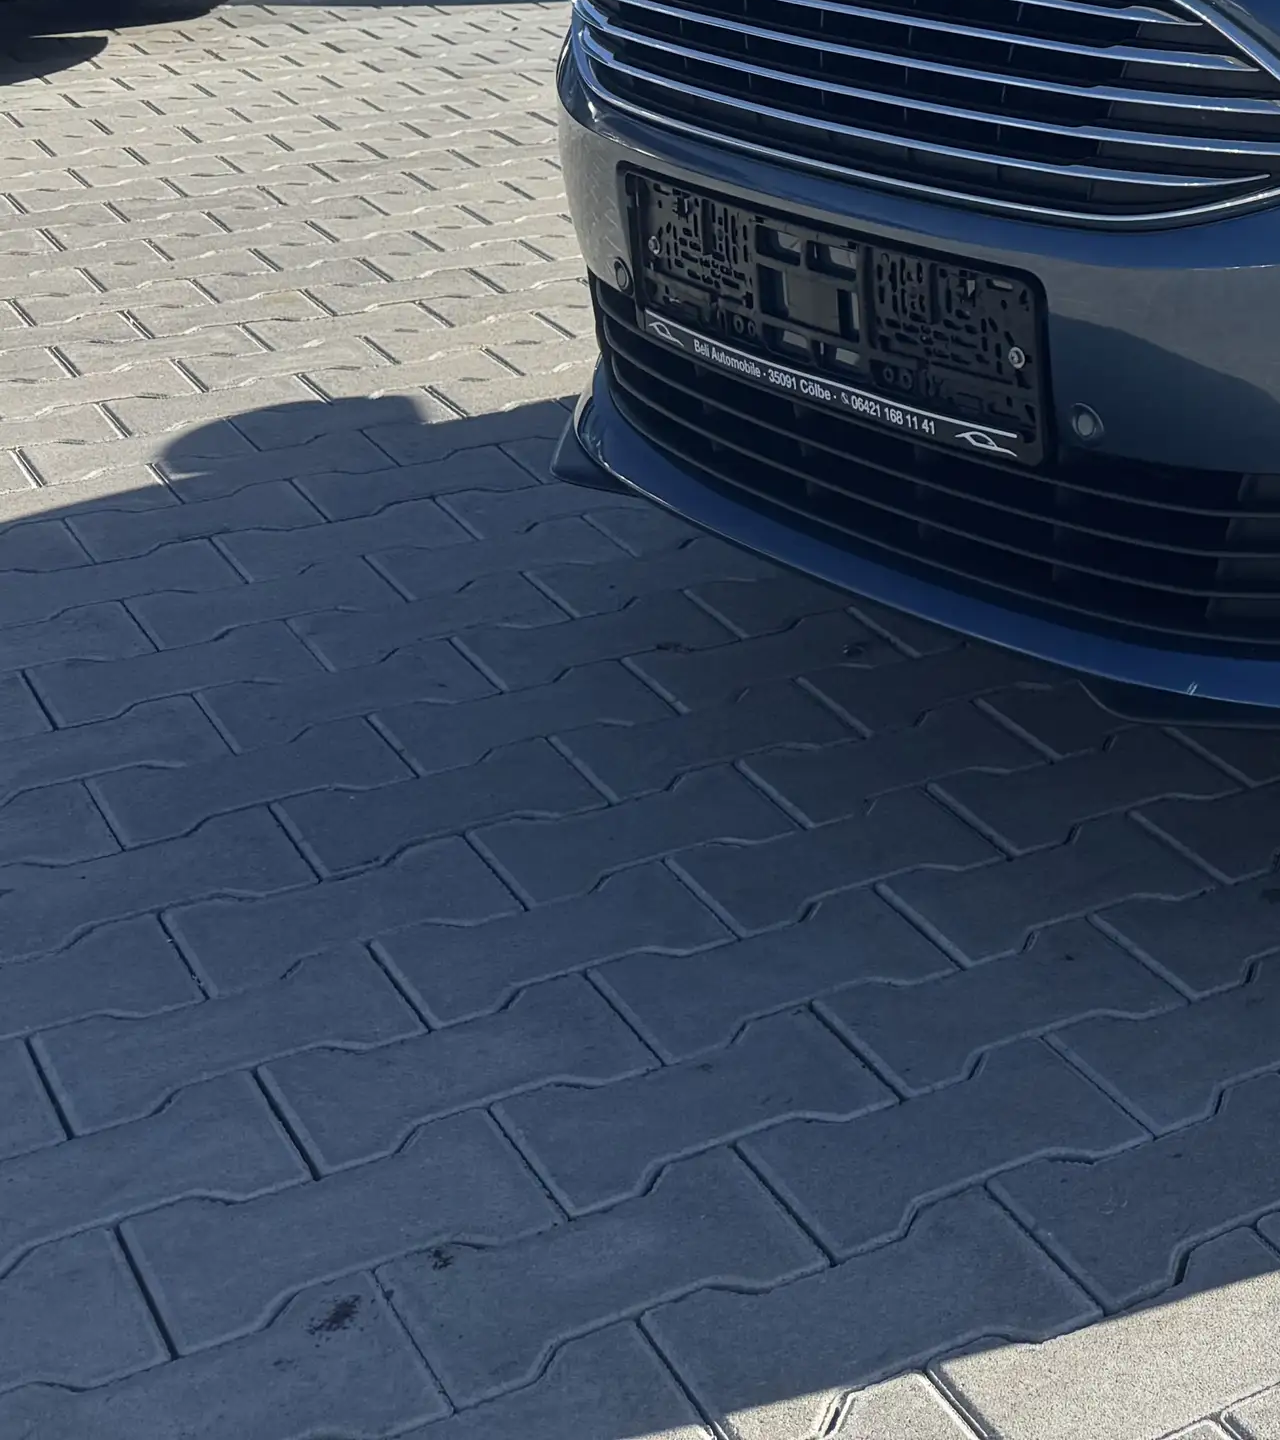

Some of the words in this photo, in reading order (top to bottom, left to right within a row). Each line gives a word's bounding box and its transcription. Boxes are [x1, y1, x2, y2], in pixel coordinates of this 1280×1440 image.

[694, 338, 709, 357] Beli
[711, 346, 761, 378] Automobile
[768, 368, 797, 390] 35091
[800, 379, 831, 400] Cölbe
[851, 394, 880, 417] 06421
[884, 407, 903, 425] 168
[906, 414, 918, 430] 11
[921, 419, 935, 435] 41
